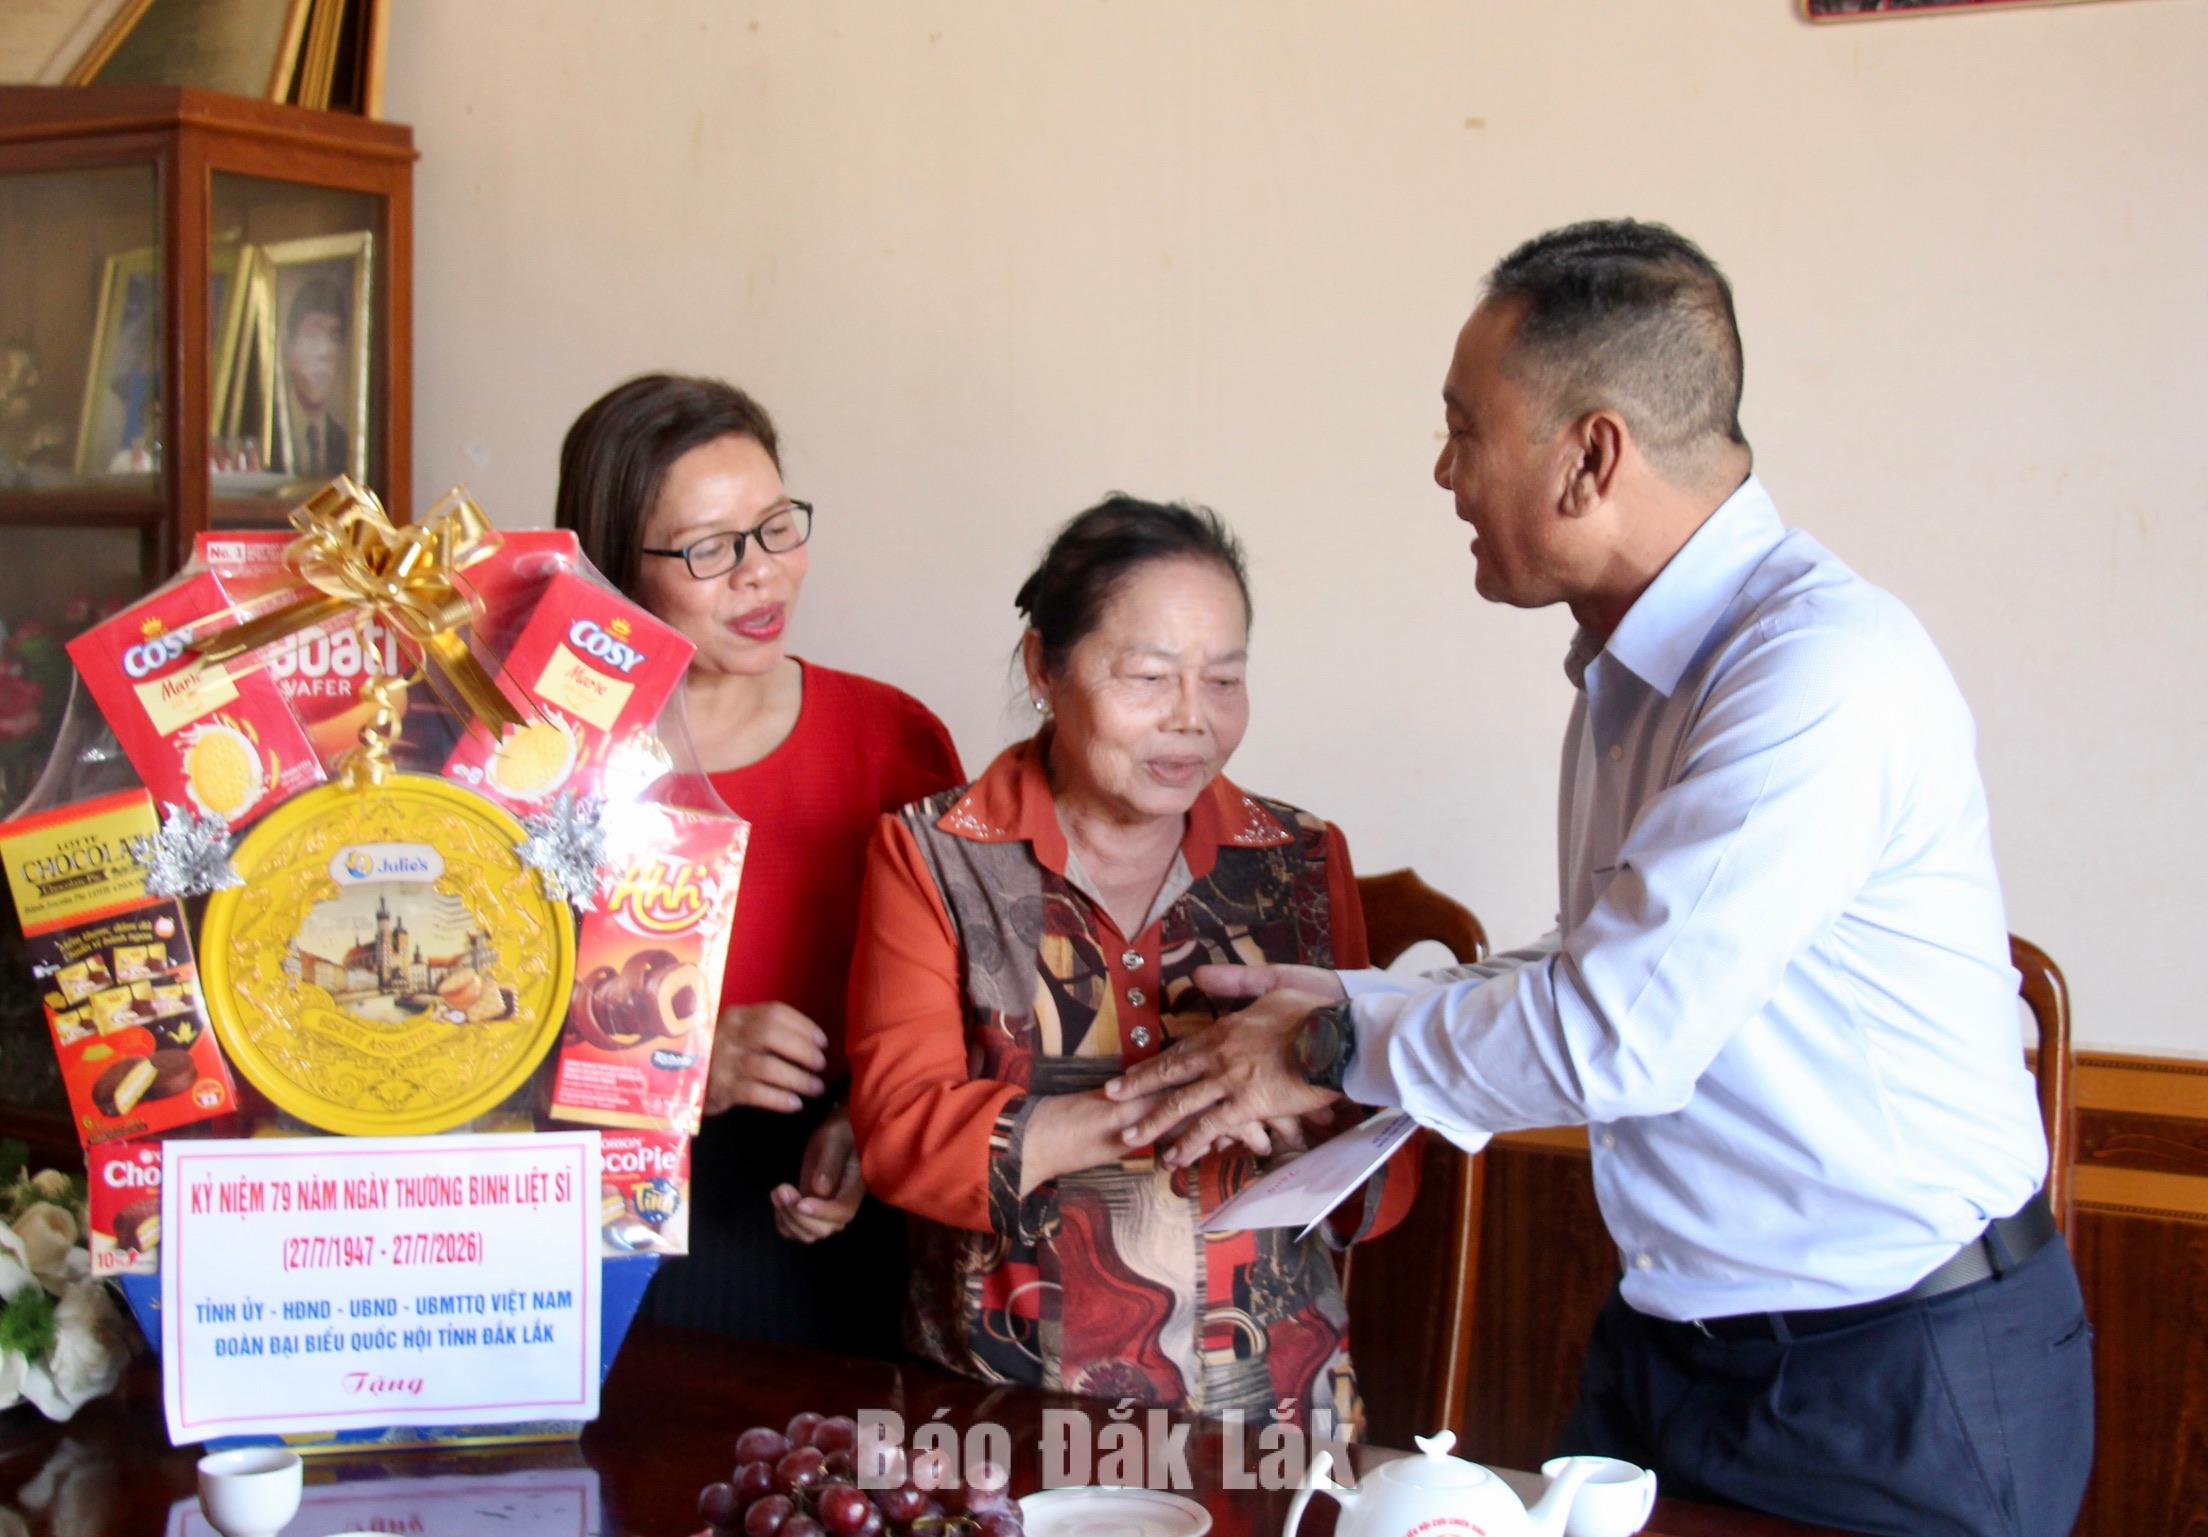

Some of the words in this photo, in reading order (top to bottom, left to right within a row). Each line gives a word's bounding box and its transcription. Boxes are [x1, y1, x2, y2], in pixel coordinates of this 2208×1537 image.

[568, 619, 647, 673] COSY
[279, 679, 353, 697] WAFER
[21, 834, 148, 884] CHOCOLA
[377, 856, 430, 873] Julie's
[191, 1171, 213, 1214] KỶ
[219, 1174, 265, 1221] NIỆM
[270, 1180, 291, 1212] 79
[297, 1172, 338, 1211] NĂM
[343, 1171, 389, 1210] NGÀY
[395, 1172, 463, 1208] THƯƠNG
[469, 1174, 509, 1206] BINH
[515, 1165, 549, 1211] LIỆT
[555, 1164, 572, 1203] SĨ
[98, 1252, 115, 1268] 10
[282, 1234, 375, 1272] (27/7/1947
[392, 1231, 484, 1265] 27/7/2026)
[194, 1296, 237, 1324] TỈNH
[242, 1295, 264, 1322] ỦY
[282, 1300, 332, 1321] HĐND
[349, 1297, 398, 1318] UBND
[415, 1293, 486, 1316] UBMTTQ
[491, 1288, 527, 1316] VIỆT
[532, 1290, 573, 1311] NAM
[215, 1331, 265, 1357] ĐOÀN
[269, 1334, 299, 1359] ĐẠI
[305, 1325, 345, 1353] BIỂU
[350, 1323, 398, 1352] QUỐC
[403, 1326, 431, 1352] HỘI
[437, 1321, 477, 1347] TỈNH
[482, 1319, 517, 1346] ĐẮK
[522, 1317, 555, 1344] LẮK
[341, 1371, 424, 1396] Tặng
